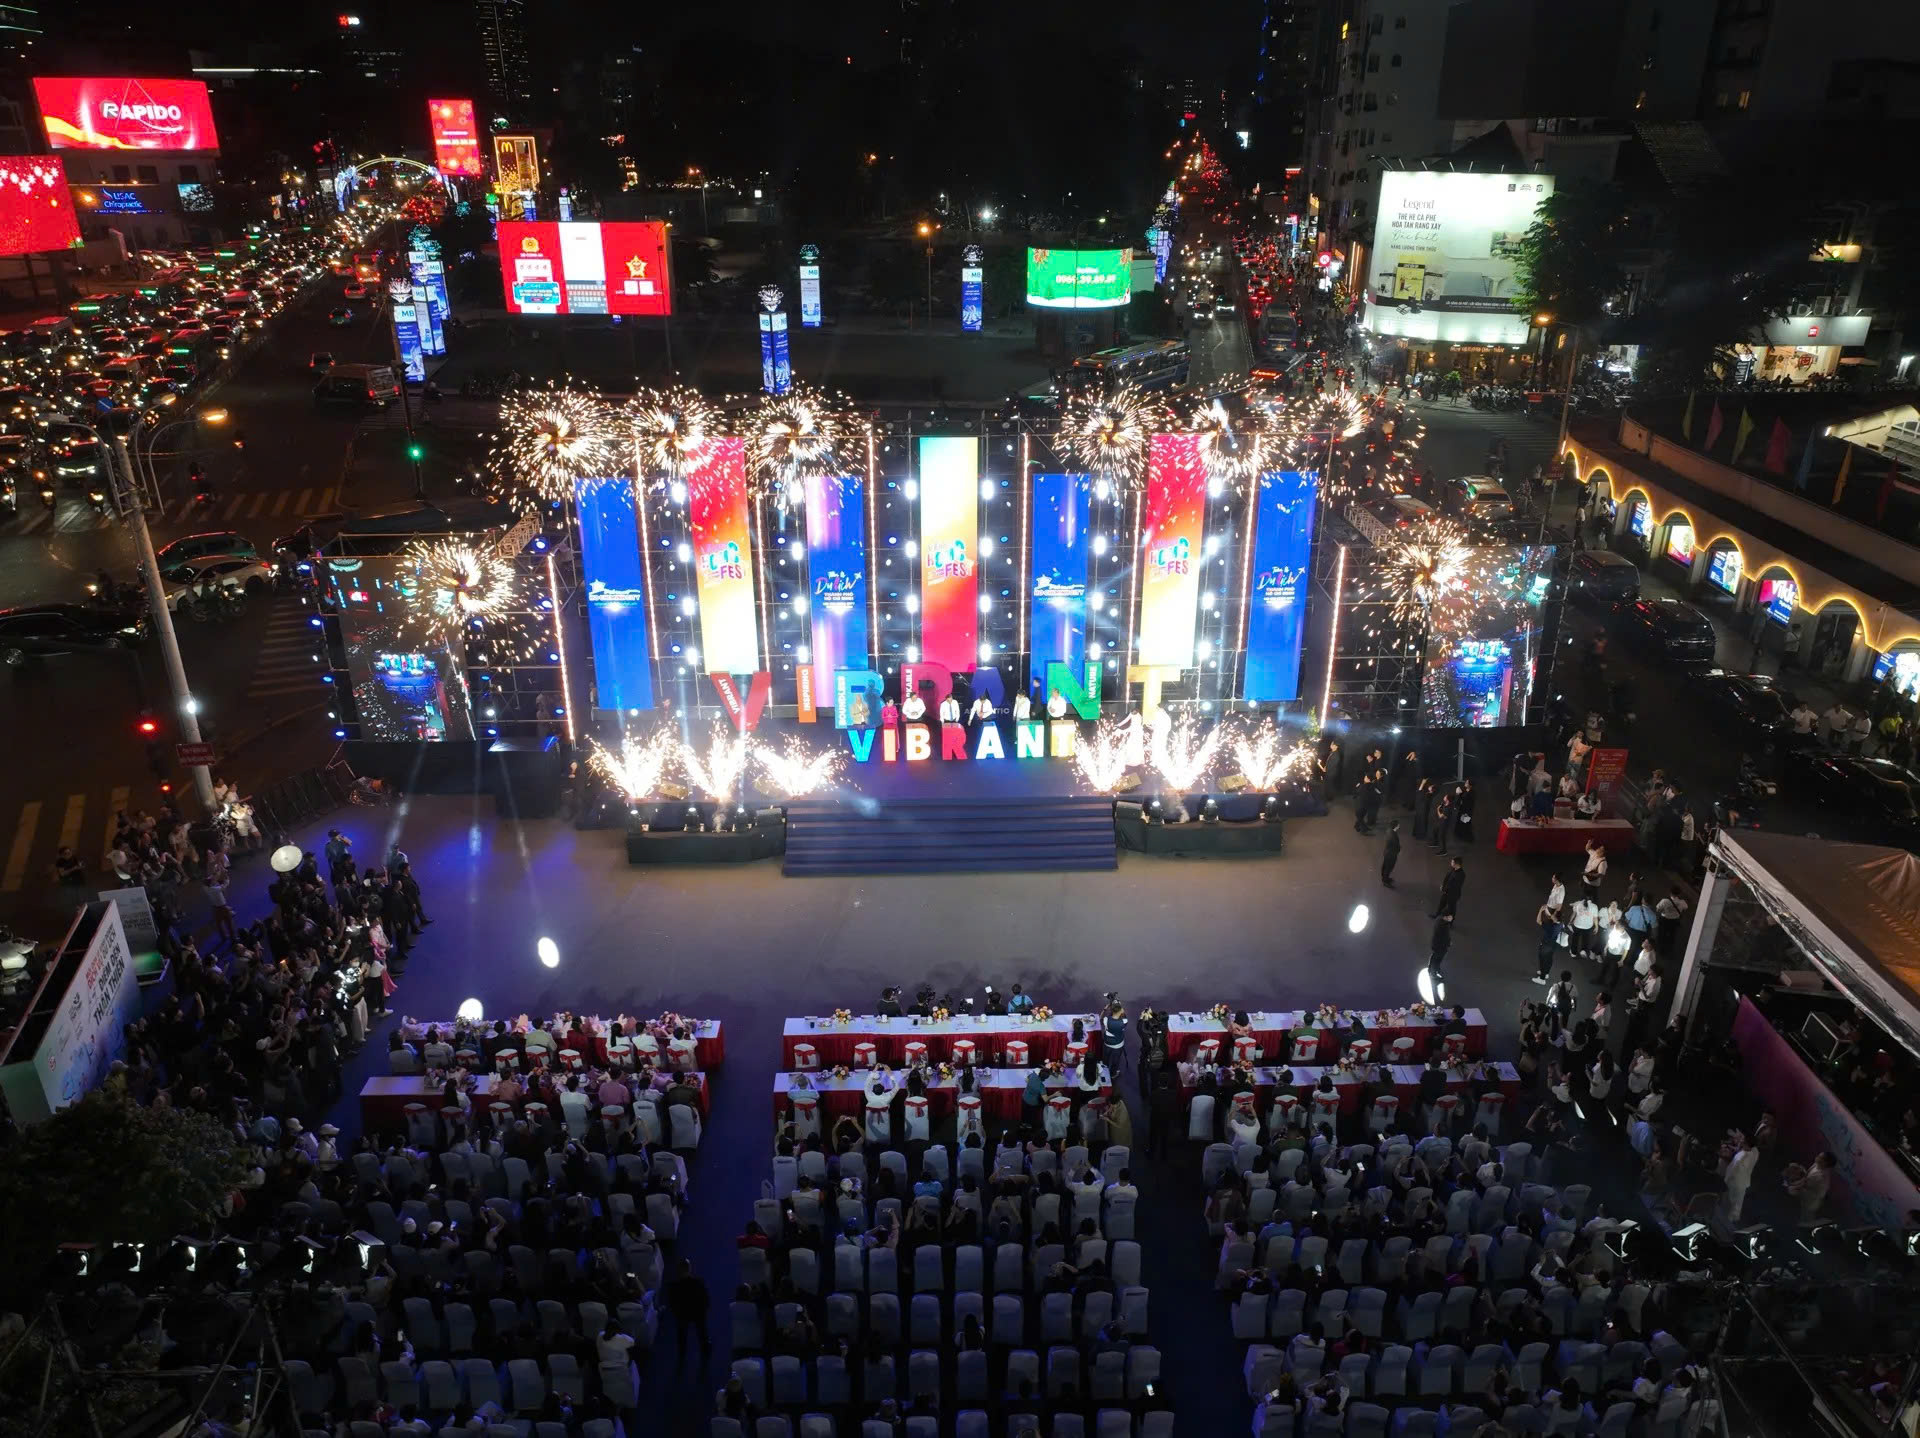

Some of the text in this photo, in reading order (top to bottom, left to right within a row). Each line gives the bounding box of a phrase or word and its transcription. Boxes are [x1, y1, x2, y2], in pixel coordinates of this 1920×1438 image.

[101, 102, 182, 120] RAPIDO
[718, 678, 740, 715] VIBRANT
[1088, 666, 1098, 699] NATURE
[847, 721, 1076, 764] VIBRANT
